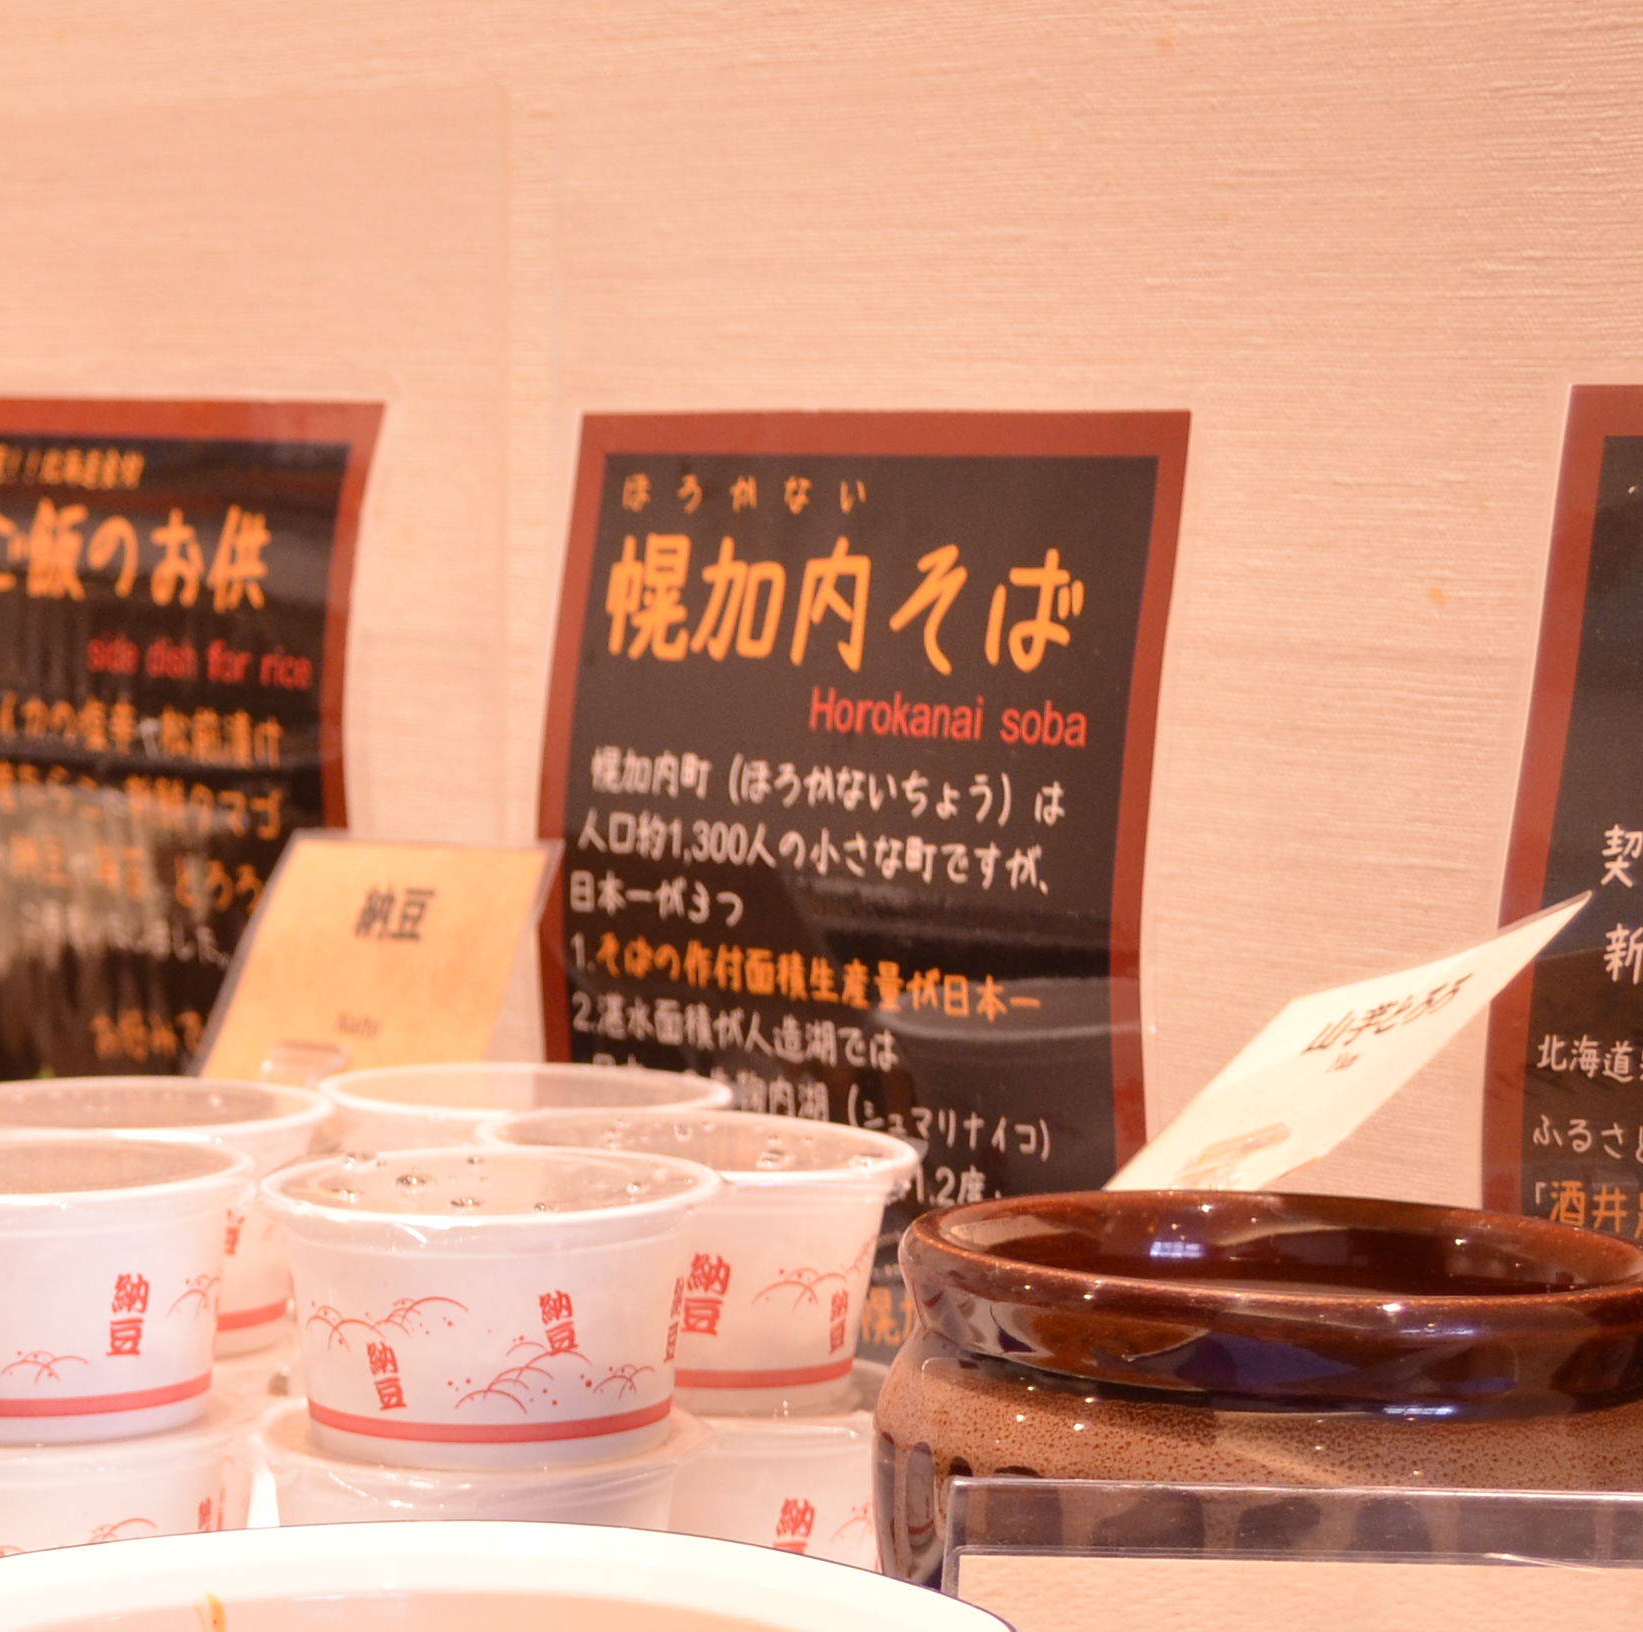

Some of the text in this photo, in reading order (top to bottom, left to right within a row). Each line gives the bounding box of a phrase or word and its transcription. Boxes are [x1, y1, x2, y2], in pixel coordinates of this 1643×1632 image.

[622, 472, 867, 514] ほろかない
[605, 533, 1085, 675] 幌加内そば
[810, 686, 1088, 749] Horokanai soba
[355, 882, 435, 941] 納豆
[1537, 1034, 1643, 1084] 北海道
[1532, 1113, 1643, 1162] ふるさ
[106, 1273, 150, 1357] 納豆
[539, 1289, 578, 1355] 納豆
[680, 1252, 731, 1338] 納豆
[366, 1341, 407, 1411] 納豆
